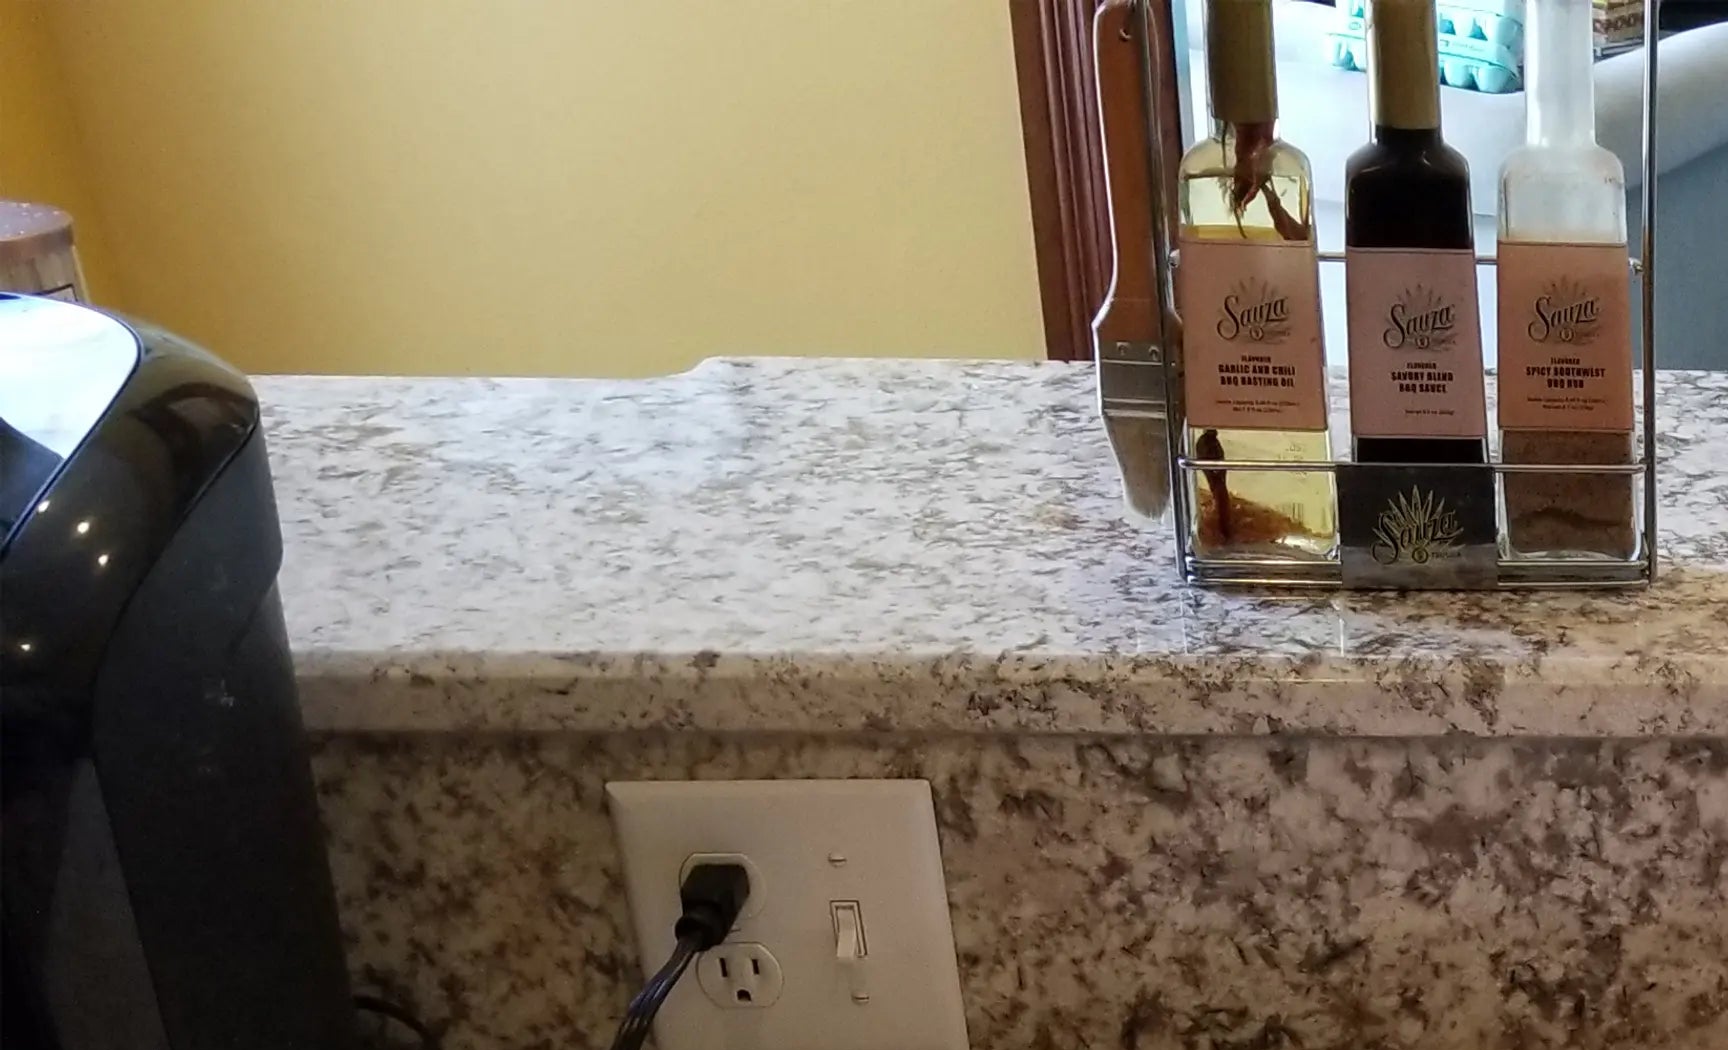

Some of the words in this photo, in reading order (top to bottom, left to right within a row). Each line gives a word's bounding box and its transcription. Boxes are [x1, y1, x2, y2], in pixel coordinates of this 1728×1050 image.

[1216, 294, 1289, 341] Sauza
[1527, 295, 1599, 342] Sauza
[1383, 303, 1455, 349] Sauza
[1218, 364, 1250, 374] GARLIC
[1251, 365, 1270, 375] AND
[1271, 366, 1296, 376] CHILI
[1526, 366, 1551, 376] SPICY
[1553, 366, 1606, 377] SOUTHWEST
[1220, 376, 1239, 387] BBQ
[1241, 376, 1279, 387] BASTING
[1280, 378, 1295, 388] OIL
[1391, 371, 1424, 381] SAVORY
[1426, 372, 1454, 382] BLEND
[1399, 383, 1417, 393] BBQ
[1419, 383, 1447, 393] SAUCE
[1547, 379, 1565, 388] BBQ
[1567, 379, 1584, 388] RUB
[1370, 510, 1462, 565] Sauza
